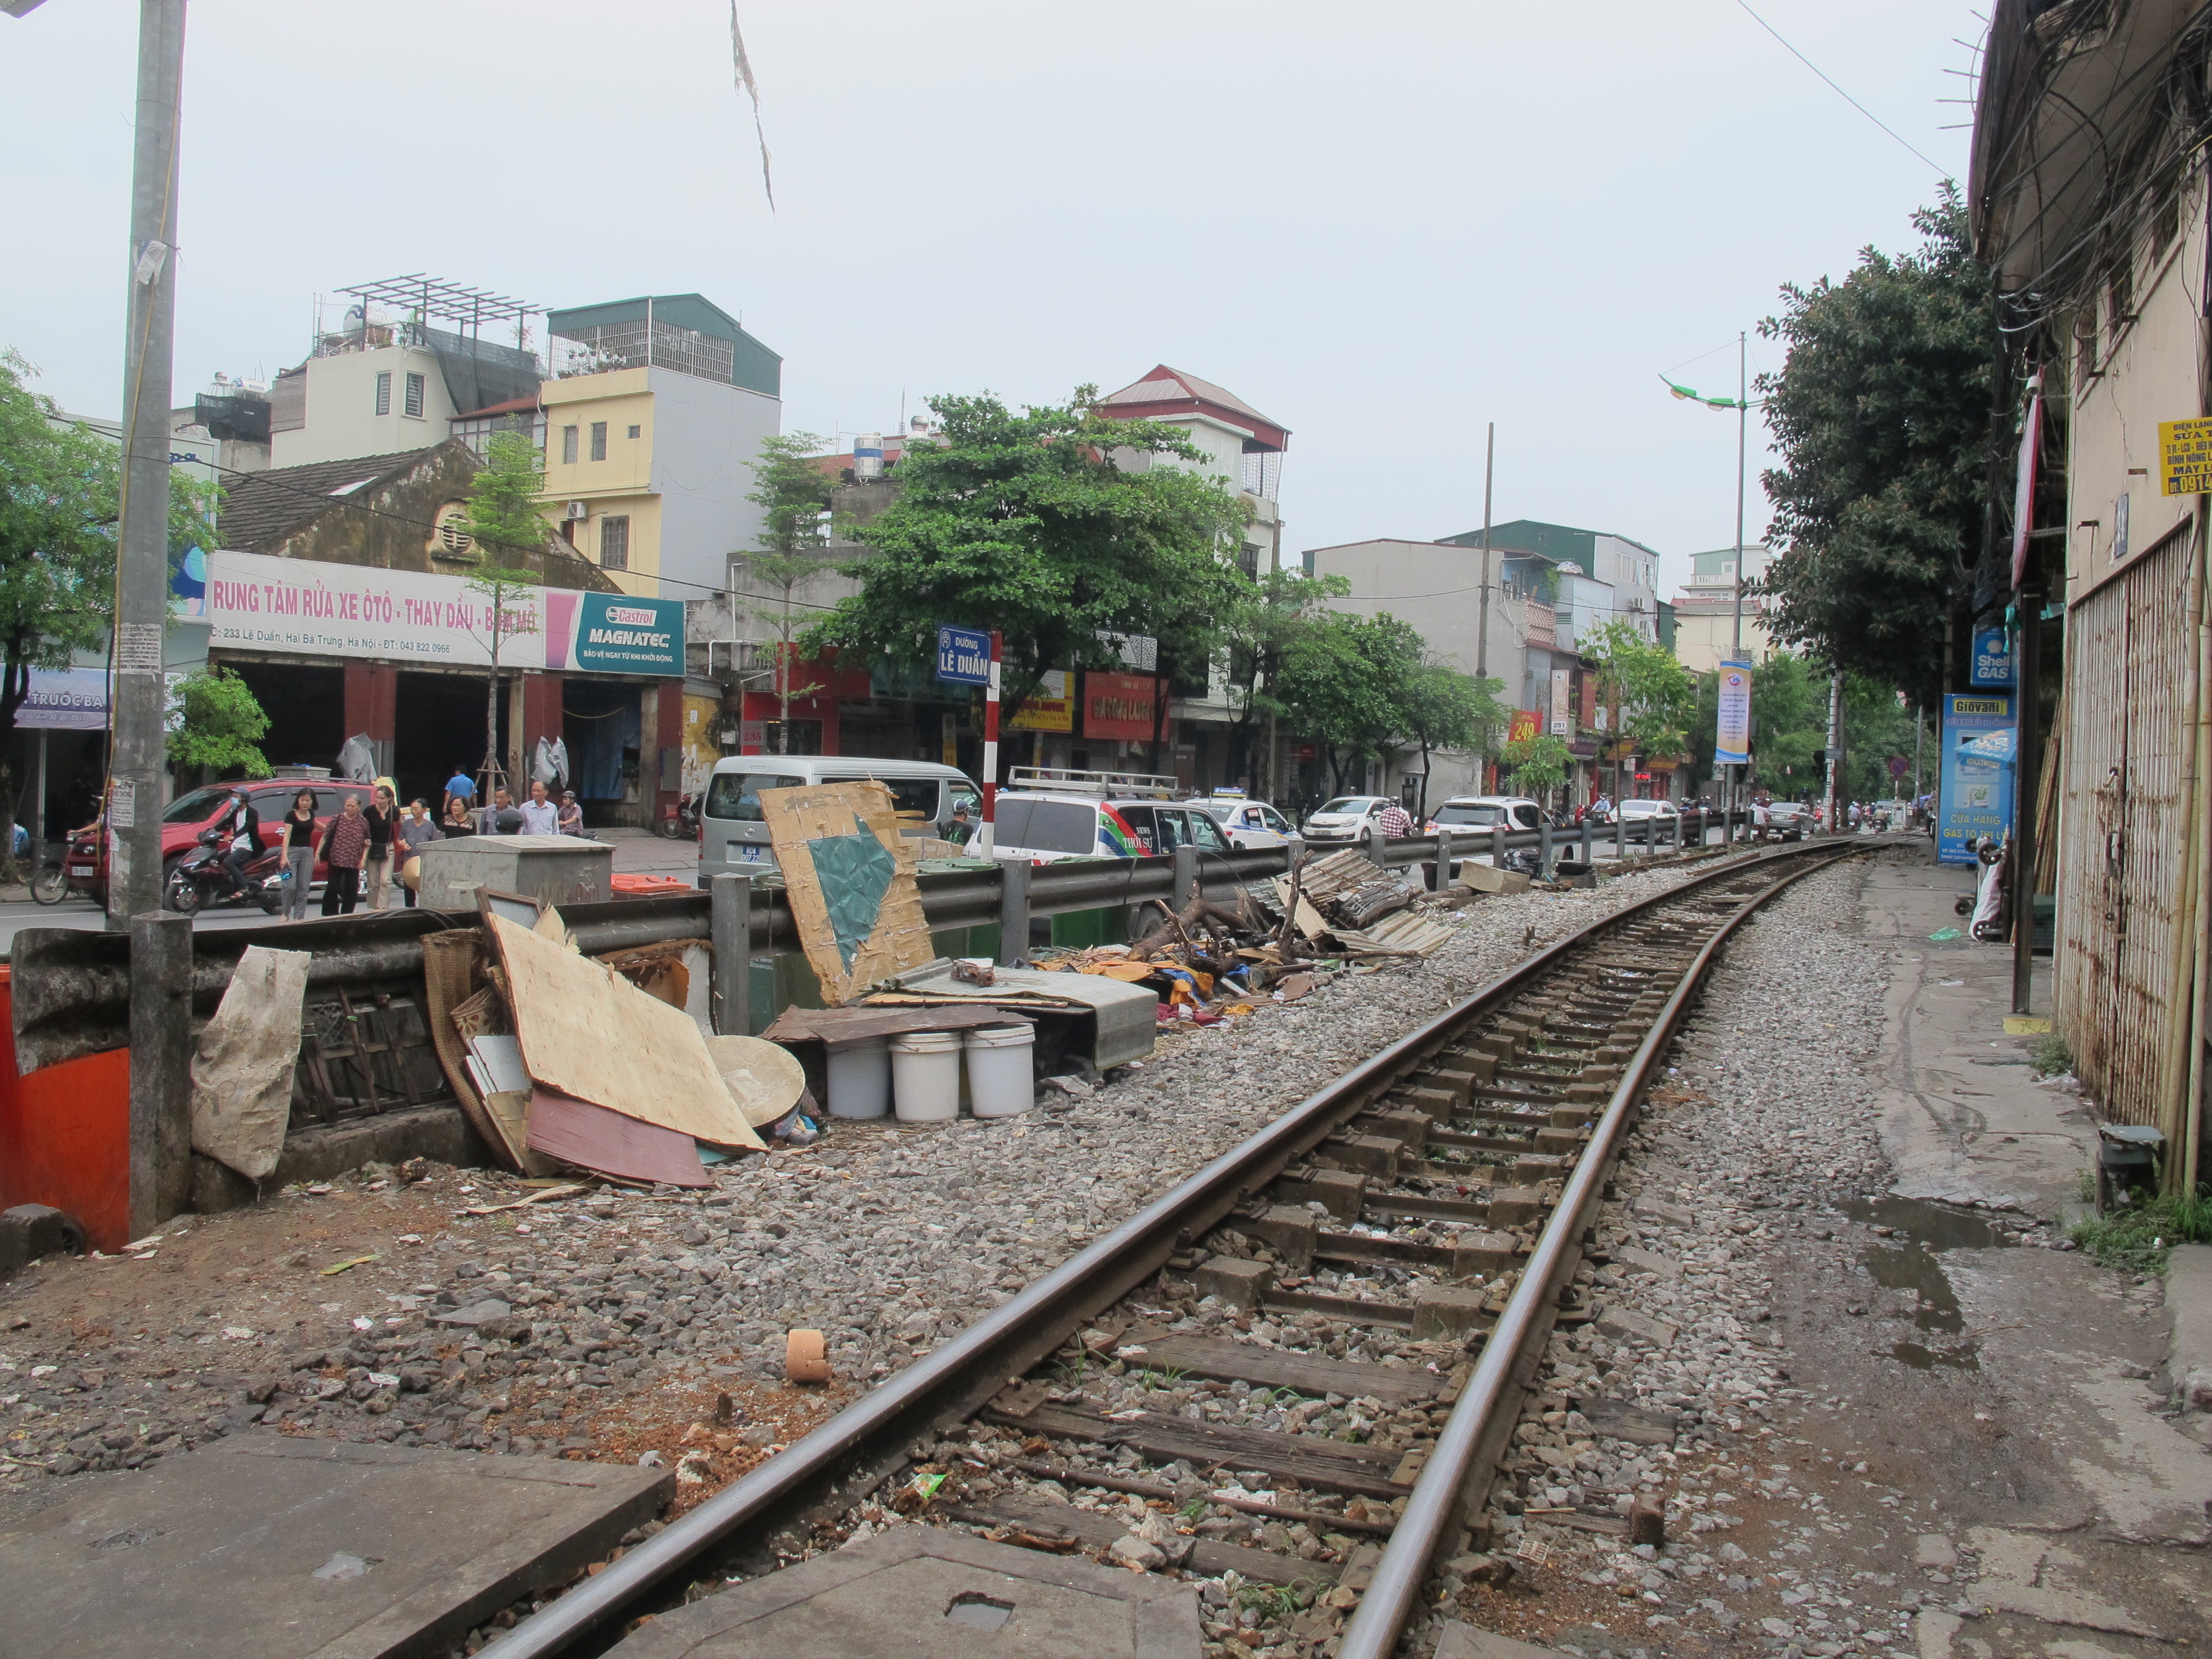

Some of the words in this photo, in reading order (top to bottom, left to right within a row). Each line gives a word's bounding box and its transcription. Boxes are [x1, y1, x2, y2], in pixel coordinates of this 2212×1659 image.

[214, 580, 260, 612] RUNG
[264, 580, 298, 615] TÂM
[303, 579, 334, 618] RỬA
[339, 592, 358, 620] XE
[363, 588, 393, 623] ÔTÔ
[404, 598, 442, 626] THAY
[446, 592, 474, 630] DẦU
[618, 609, 653, 624] Castrol
[212, 626, 221, 637] C:
[224, 628, 240, 638] 233
[243, 629, 253, 640] Lê
[286, 632, 300, 643] Hai
[303, 632, 315, 644] Bà
[318, 635, 345, 648] Trưng,
[348, 636, 359, 647] Hà
[362, 638, 376, 650] Nội
[384, 640, 398, 650] ĐT:
[400, 640, 414, 651] 043
[417, 642, 430, 652] 822
[432, 643, 450, 653] 0966
[589, 628, 671, 648] MAGNATEC
[955, 636, 978, 649] ĐƯỜNG
[583, 649, 597, 657] BẢO
[597, 650, 605, 660] VỆ
[656, 654, 673, 663] ĐỘNG
[941, 650, 954, 672] LÊ
[957, 651, 988, 676] DUẨN
[1977, 655, 2010, 666] Shell
[1977, 667, 2009, 679] GAS
[1956, 701, 2000, 713] Giovani
[743, 732, 762, 742] 235
[1950, 811, 1969, 823] CỬA
[1972, 813, 2000, 825] HÀNG
[1943, 828, 1962, 838] GAS
